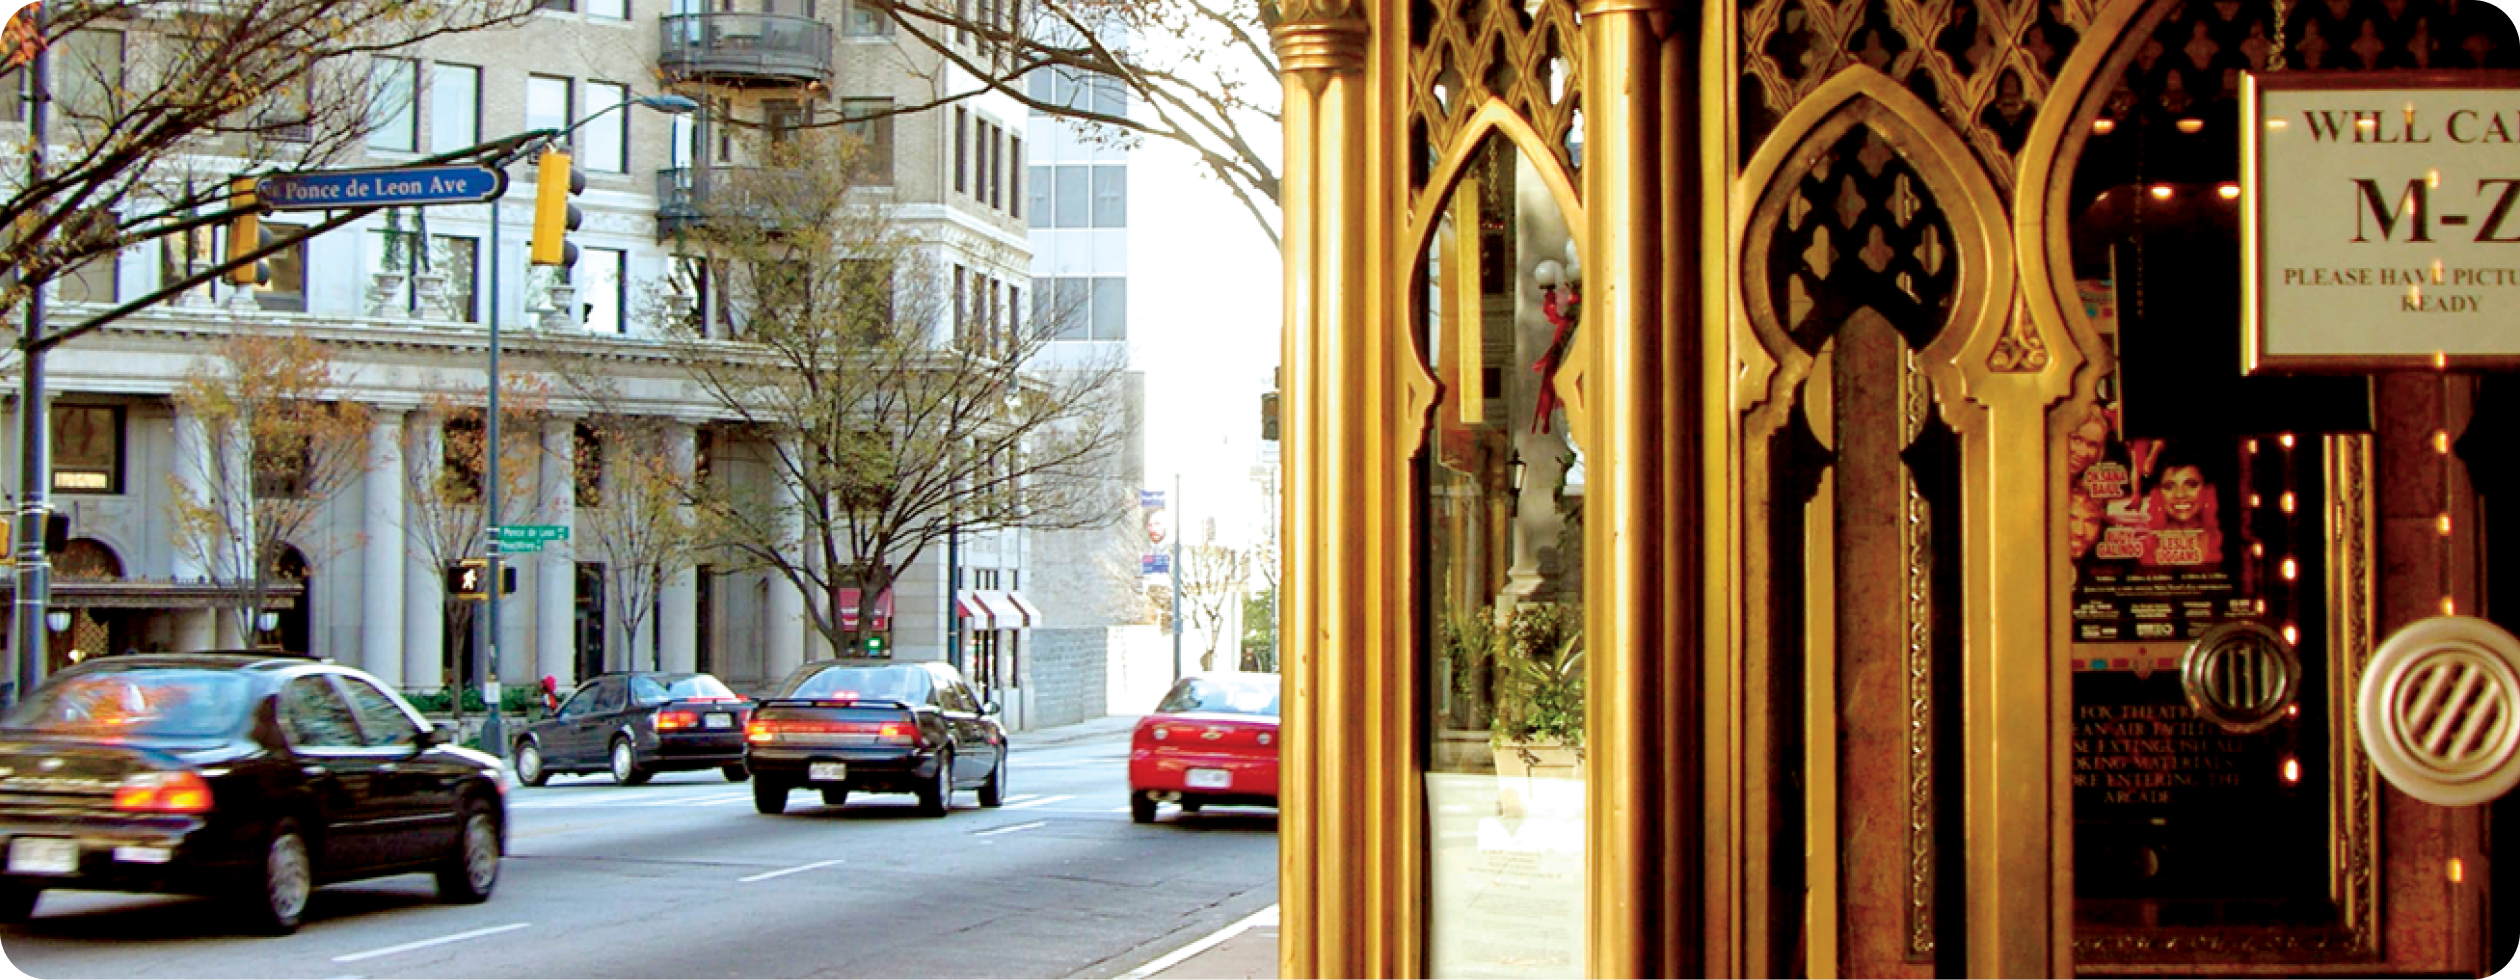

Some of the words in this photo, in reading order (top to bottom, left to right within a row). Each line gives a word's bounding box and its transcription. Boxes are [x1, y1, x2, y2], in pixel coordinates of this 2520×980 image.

[2303, 109, 2432, 143] WILL
[2446, 109, 2520, 143] CA
[285, 182, 341, 200] Ponce
[345, 179, 370, 198] de
[375, 177, 423, 197] Leon
[428, 175, 468, 195] Ave
[2348, 178, 2520, 243] M-Z
[2283, 268, 2372, 286] PLEASE
[2379, 268, 2446, 286] HAVE
[2401, 295, 2483, 312] READY
[503, 527, 525, 537] Ponce
[2080, 705, 2112, 719] FOX
[2122, 705, 2197, 719] THEATR
